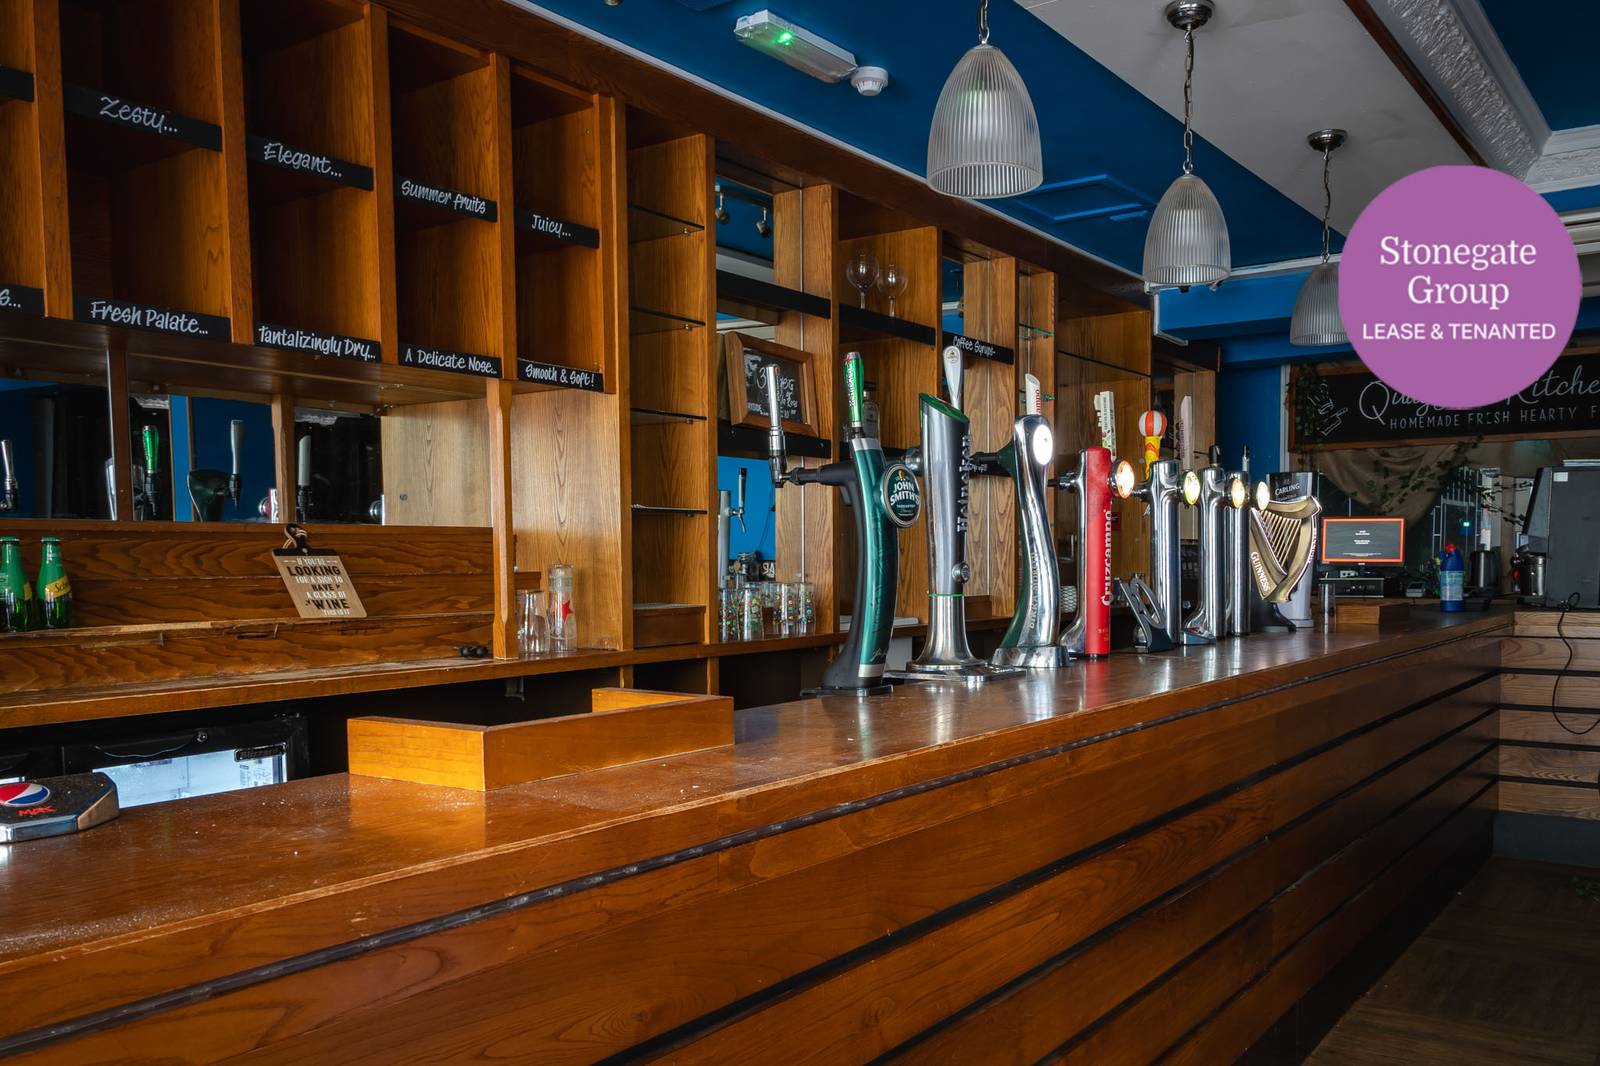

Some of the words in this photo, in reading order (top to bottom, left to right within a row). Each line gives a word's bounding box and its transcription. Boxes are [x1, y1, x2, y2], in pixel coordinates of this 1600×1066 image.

[401, 180, 452, 204] Summer
[90, 301, 141, 326] Fresh
[258, 325, 342, 357] Tantalizingly
[405, 349, 413, 362] A
[417, 350, 466, 370] Delicate
[525, 364, 557, 383] Smooth
[560, 371, 569, 383] &
[570, 372, 595, 388] Soft!
[1390, 414, 1460, 430] HOMEMADE
[1468, 411, 1510, 425] FRESH
[1520, 407, 1577, 422] HEARTY
[893, 481, 915, 493] JOHN
[1275, 482, 1301, 496] CARLING
[890, 491, 920, 506] SMITH'S
[286, 566, 341, 577] LOOKING
[1250, 551, 1271, 592] GUINNESS
[312, 599, 350, 610] WINE
